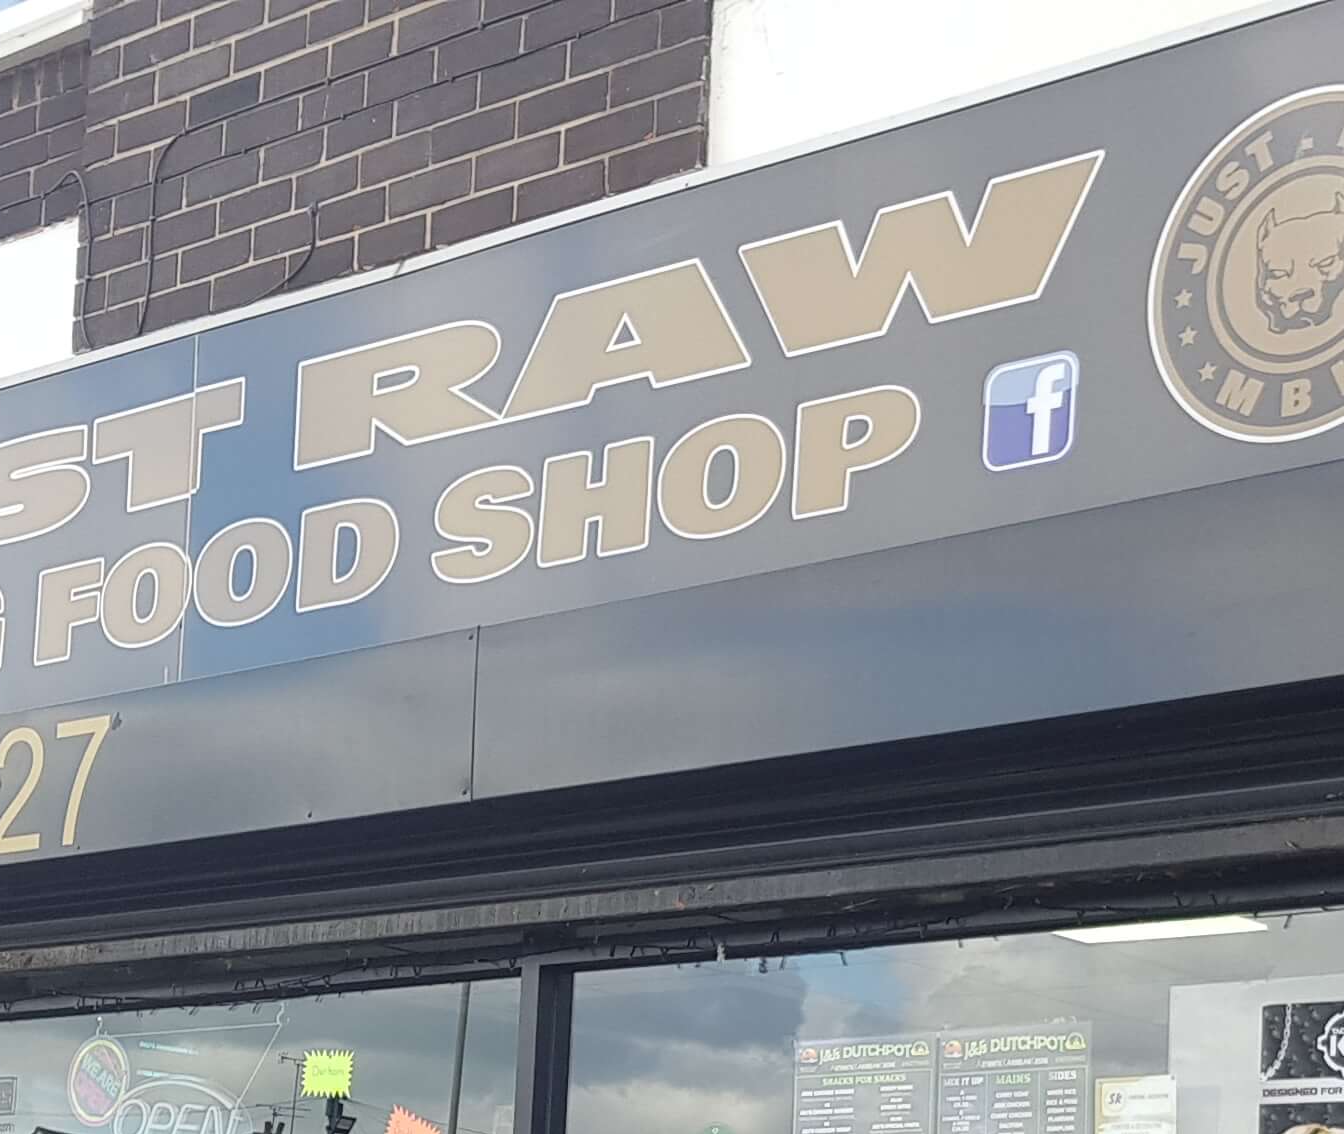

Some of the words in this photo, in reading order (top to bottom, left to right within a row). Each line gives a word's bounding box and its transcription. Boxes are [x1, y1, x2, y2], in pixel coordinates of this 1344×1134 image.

[1177, 130, 1275, 274] JUST
[293, 149, 1105, 471] RAW
[33, 497, 399, 668] FOOD
[430, 385, 921, 584] SHOP
[843, 1044, 912, 1058] DUTCHPOT
[990, 1036, 1066, 1052] DUTCHPOT
[996, 1073, 1031, 1084] MAINS
[1048, 1070, 1076, 1080] SIDES
[1263, 1087, 1317, 1097] DESIGNED
[1321, 1087, 1342, 1096] FOR
